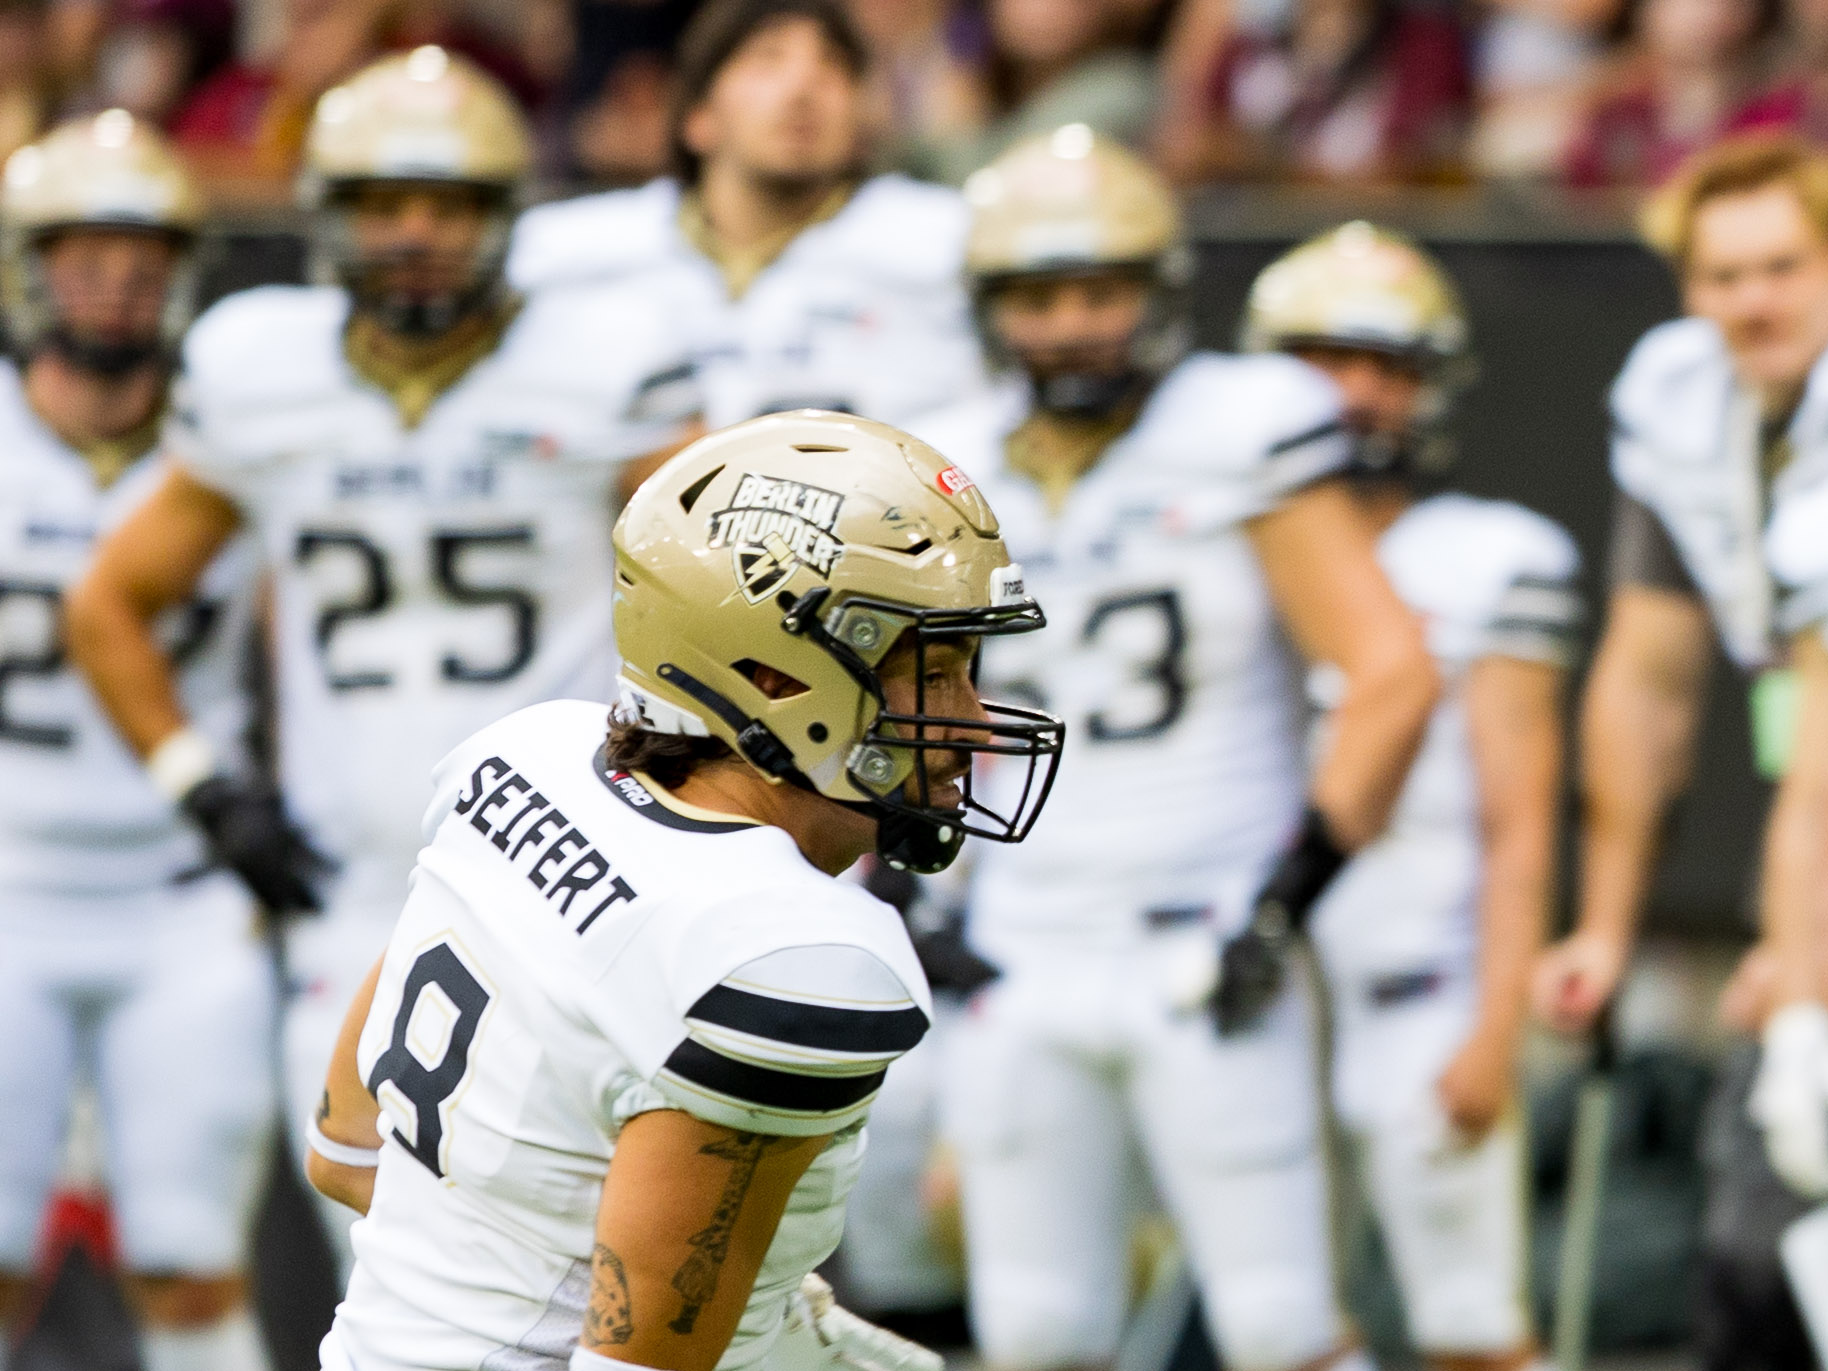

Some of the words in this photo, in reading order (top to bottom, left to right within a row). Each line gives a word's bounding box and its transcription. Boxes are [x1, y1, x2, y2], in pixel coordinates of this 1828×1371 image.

[708, 509, 838, 574] THUNDER
[731, 475, 841, 531] BERLIN
[295, 522, 540, 692] 25
[455, 757, 638, 936] SEIFERT
